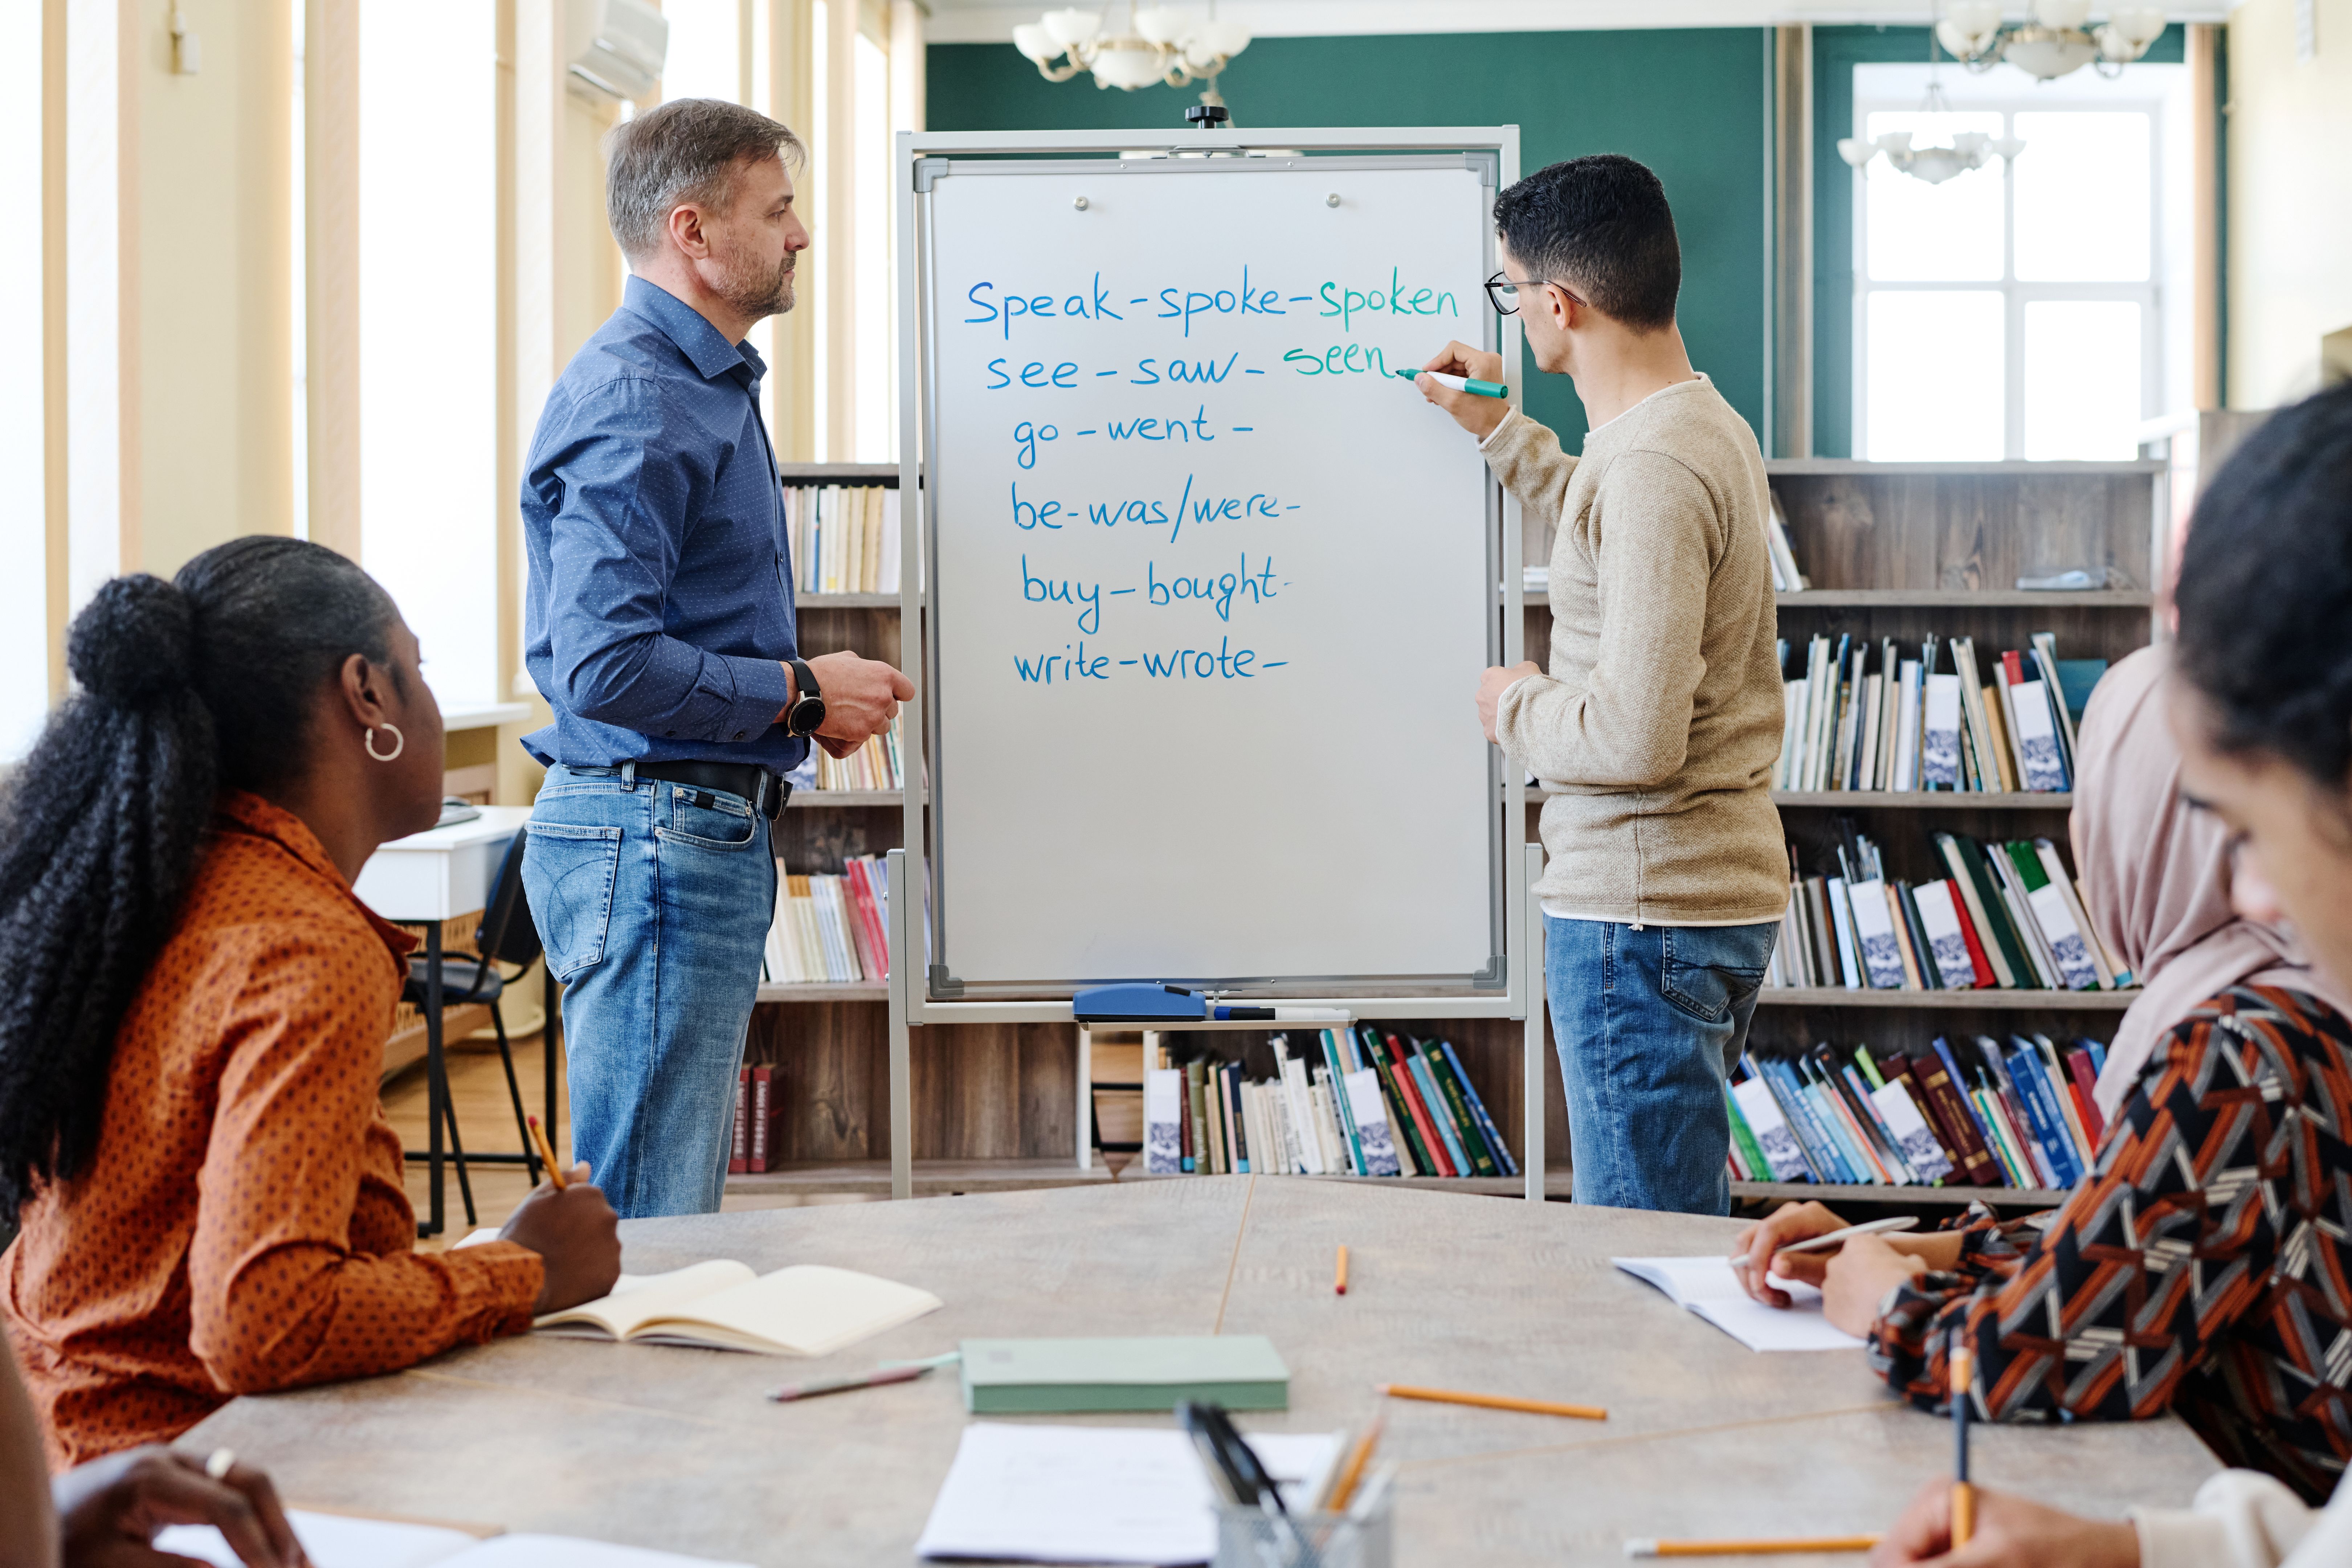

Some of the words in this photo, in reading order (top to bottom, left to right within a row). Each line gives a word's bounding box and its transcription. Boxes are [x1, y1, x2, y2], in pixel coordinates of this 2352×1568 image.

[987, 358, 1079, 390] see
[1130, 352, 1239, 385] saw
[1283, 343, 1396, 379] seen
[1013, 421, 1059, 470] go
[1107, 404, 1215, 442] went
[1021, 553, 1100, 635] buy
